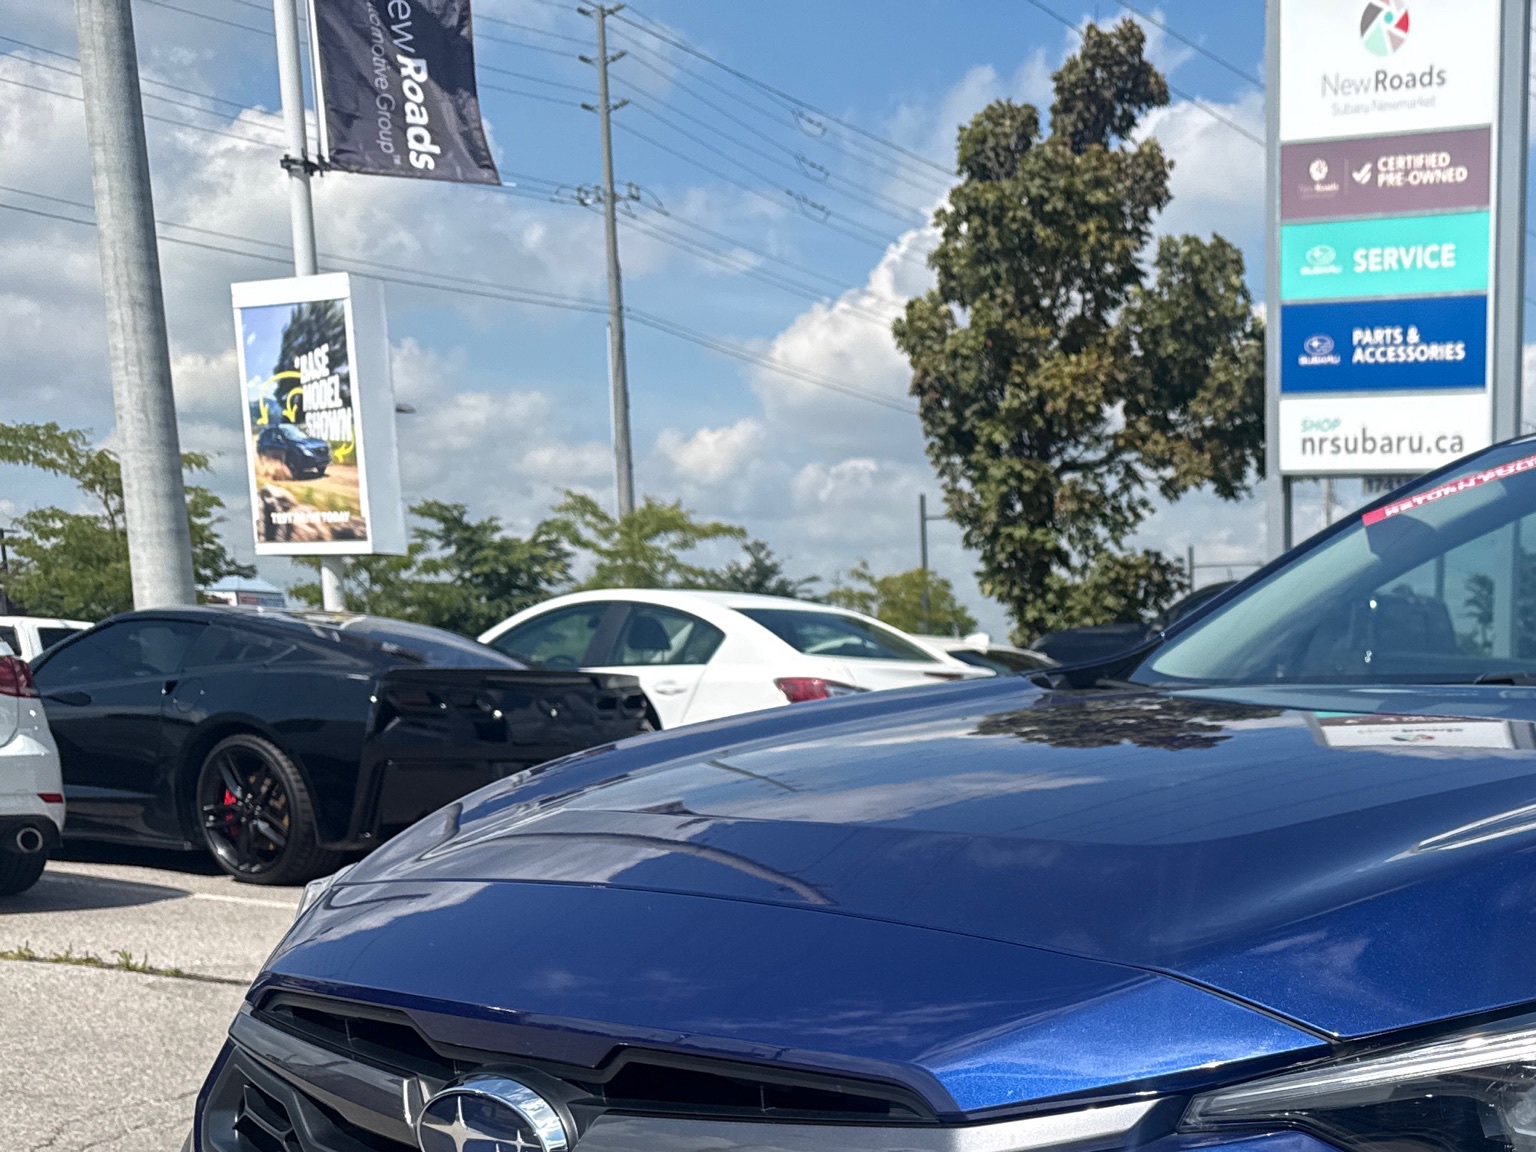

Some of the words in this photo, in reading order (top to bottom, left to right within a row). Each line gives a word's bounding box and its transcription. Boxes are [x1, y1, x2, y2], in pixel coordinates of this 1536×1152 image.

[387, 0, 441, 170] ewRoads
[376, 93, 396, 154] Group
[1377, 152, 1451, 172] CERTIFIED
[1377, 165, 1468, 188] PRE-OWNED
[1353, 243, 1456, 273] SERVICE
[1352, 327, 1403, 346] PARTS
[1406, 325, 1420, 343] &
[1352, 341, 1466, 363] ACCESSORIES
[302, 374, 343, 413] MODEL
[305, 407, 353, 442] SHOWN
[1301, 418, 1341, 433] SHOP
[1301, 425, 1464, 455] nrsubaru.ca
